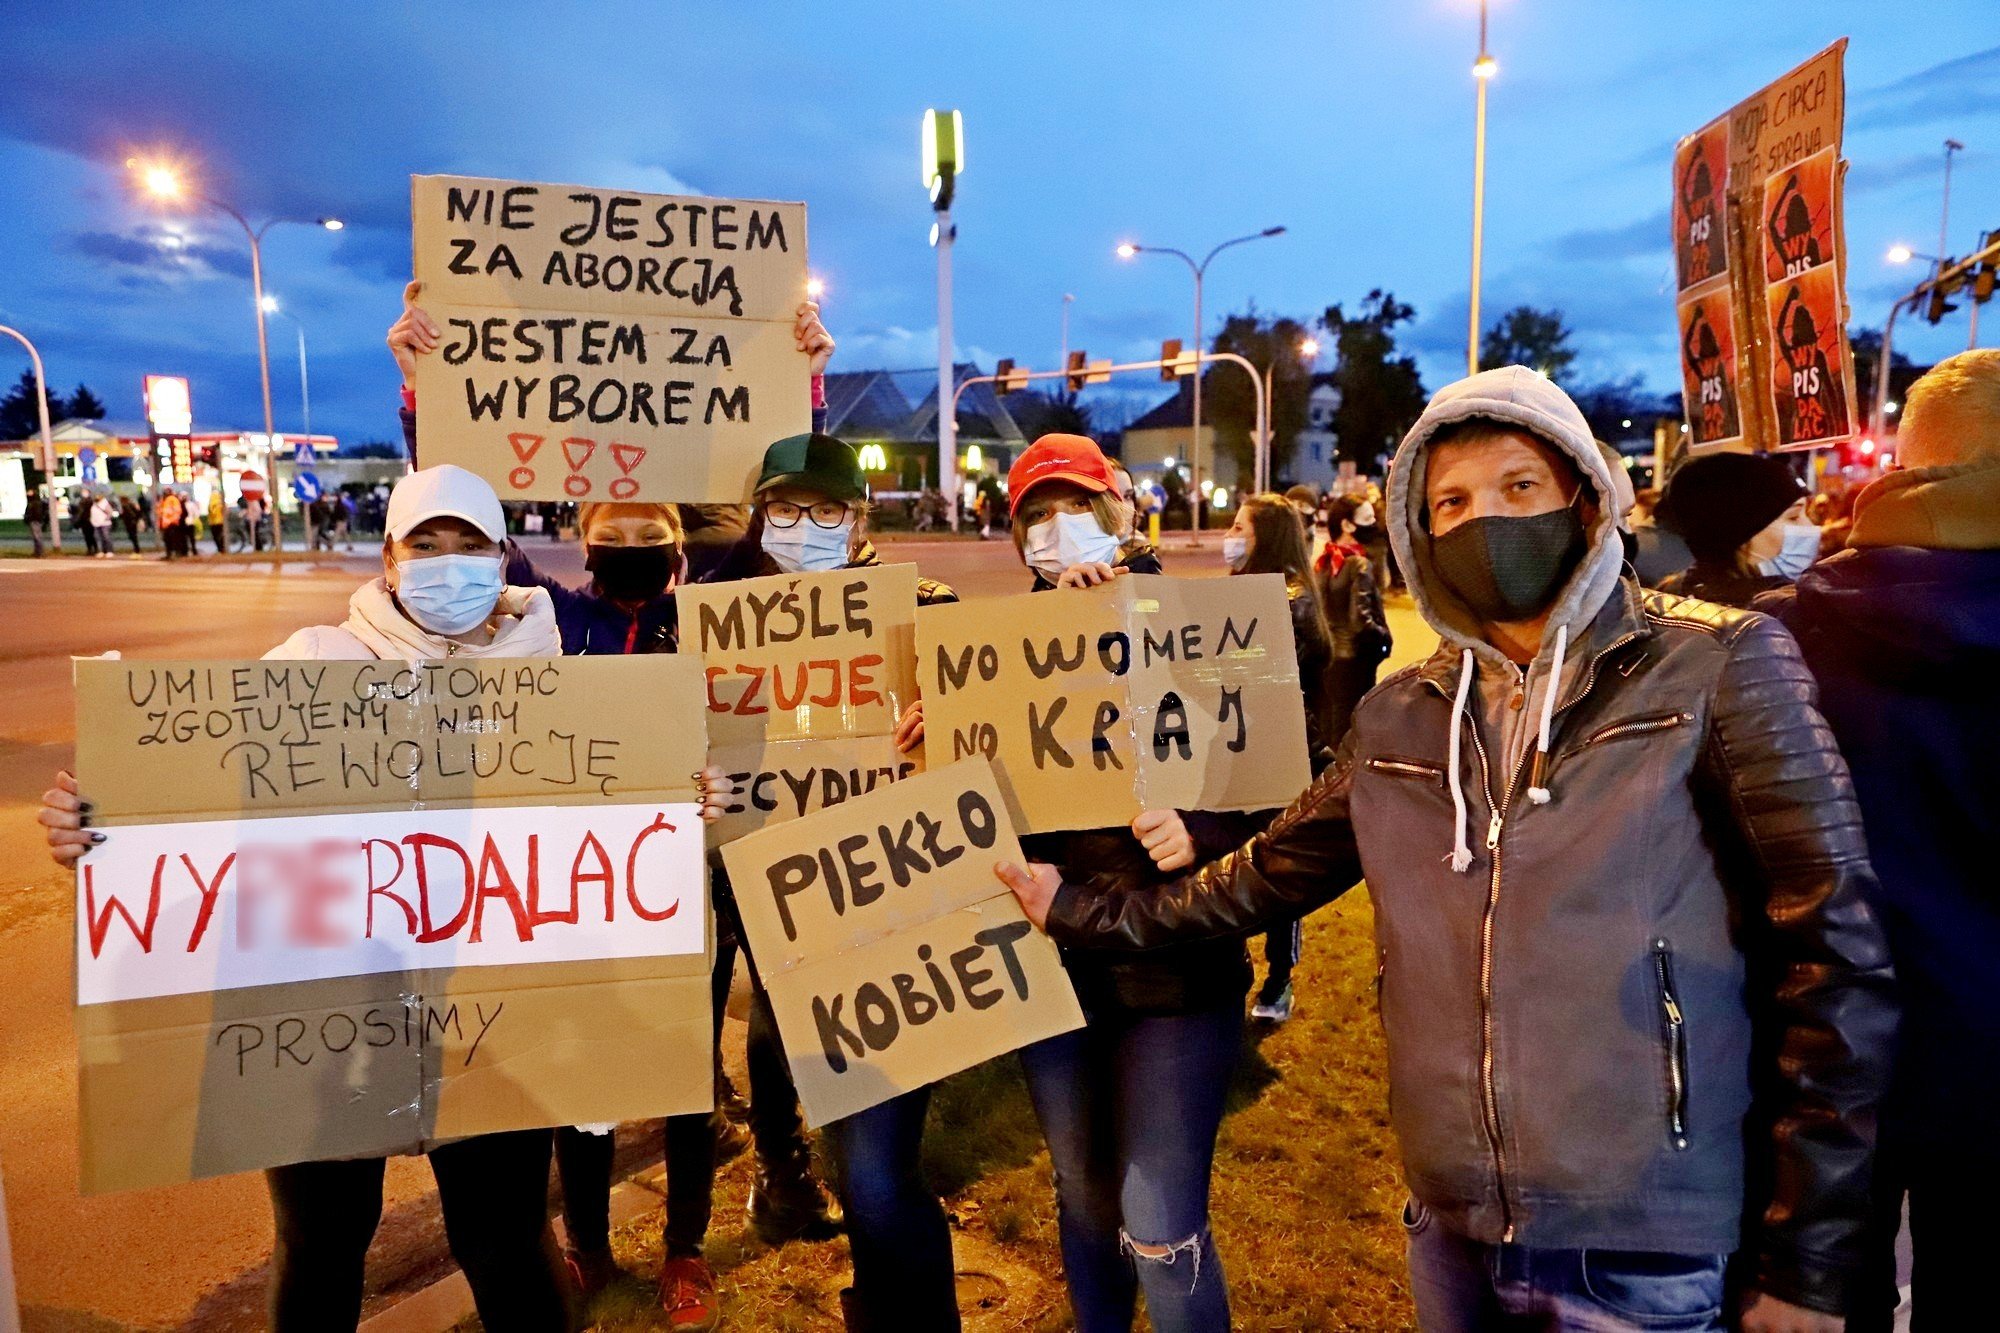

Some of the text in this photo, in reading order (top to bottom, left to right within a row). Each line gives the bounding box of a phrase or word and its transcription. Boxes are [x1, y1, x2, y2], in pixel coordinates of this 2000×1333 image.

[1773, 70, 1827, 128] CIPKA
[446, 186, 789, 252] NIE JESTEM
[1690, 214, 1711, 247] PIS
[447, 238, 744, 316] ZA ABORCJĄ
[442, 317, 733, 367] JESTEM ZA
[465, 373, 751, 428] WYBOREM
[1701, 376, 1722, 404] PIS
[1793, 366, 1820, 398] PIS
[699, 579, 873, 653] MYŚLĘ
[128, 661, 560, 708] UMIEMY GOTOWAĆ
[937, 616, 1258, 695] NO WOMEN
[138, 701, 519, 747] ZGOTUJEMY WAM
[953, 685, 1247, 771] NO KRAJ
[220, 729, 620, 798] REWOLUCJĘ
[724, 761, 916, 818] ECYDU
[765, 789, 997, 942] PIEKŁO
[215, 1002, 504, 1077] PROSIMY
